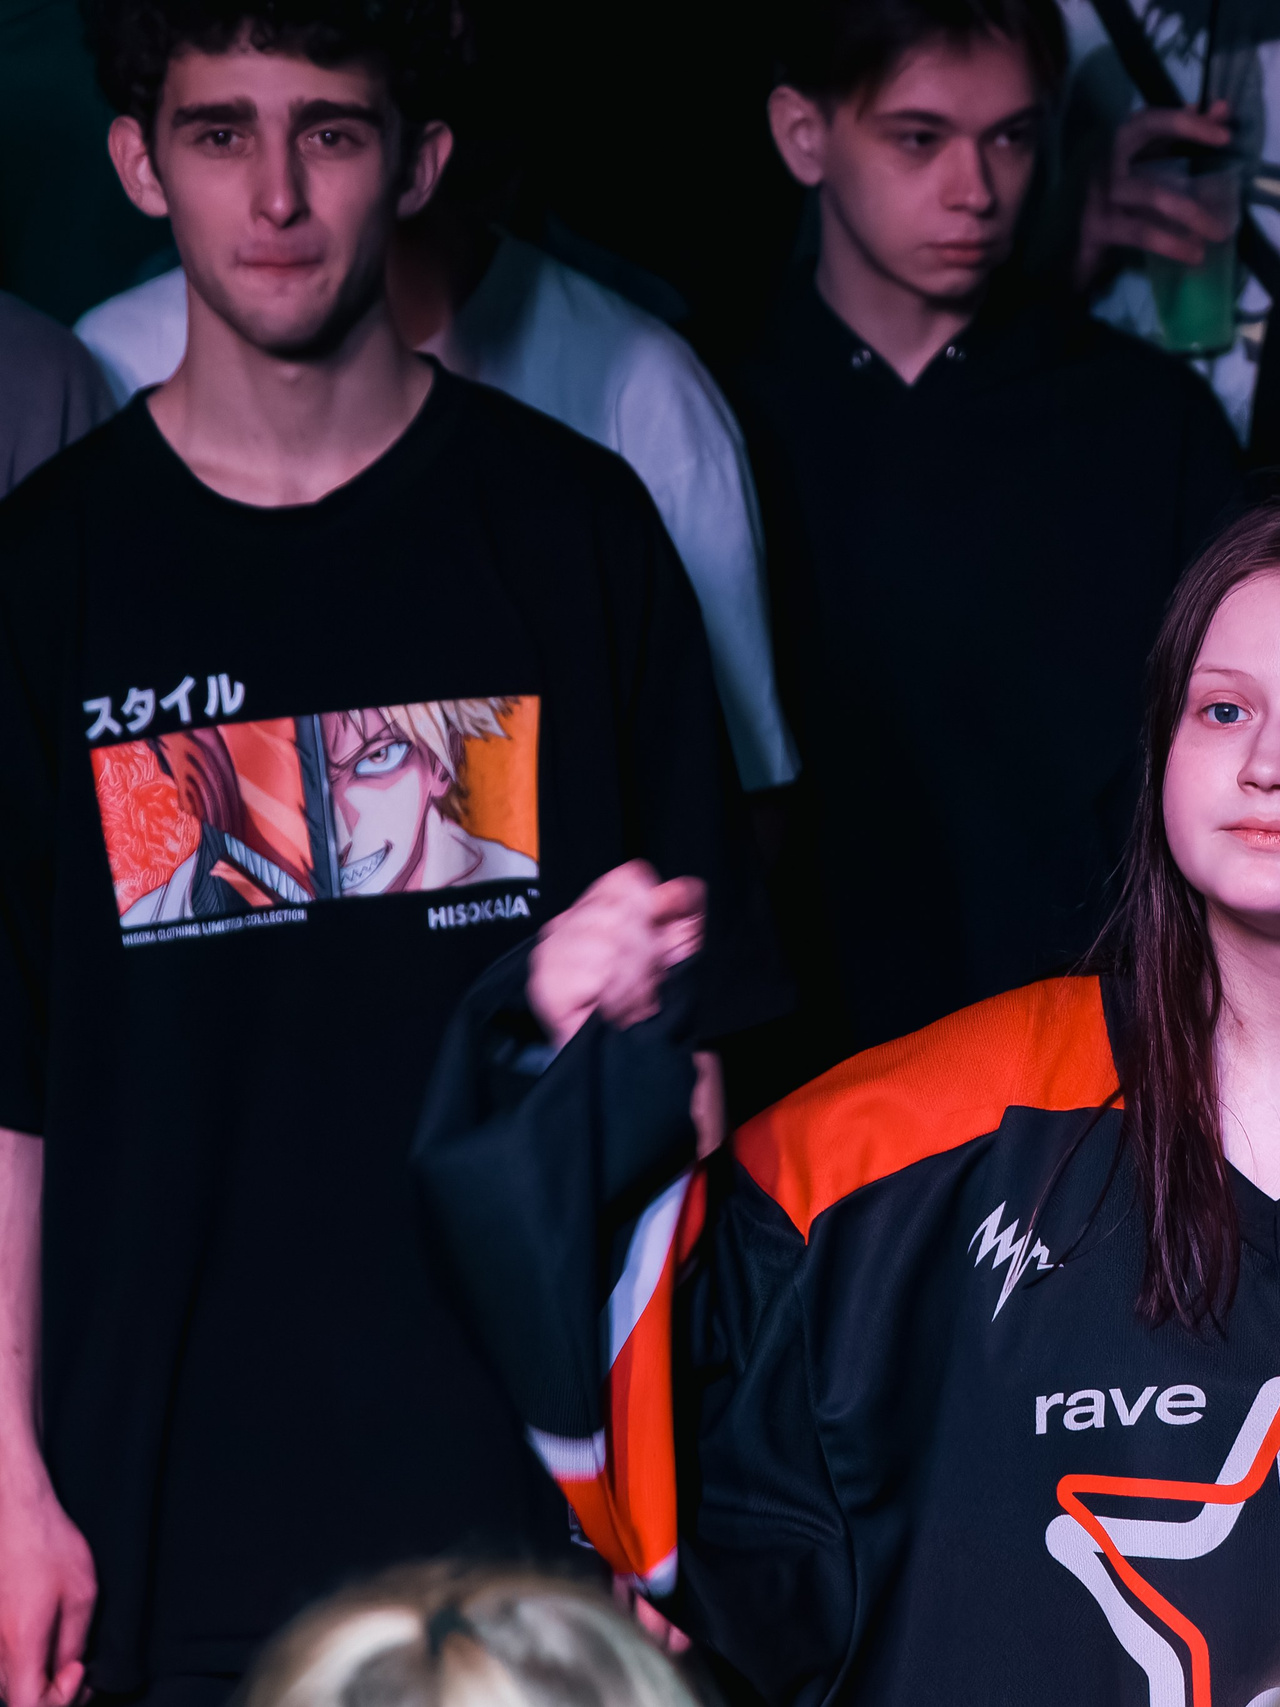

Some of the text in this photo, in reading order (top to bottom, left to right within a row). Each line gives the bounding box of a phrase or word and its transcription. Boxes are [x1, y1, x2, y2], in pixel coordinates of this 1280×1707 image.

[82, 673, 245, 741] スタイル
[243, 908, 308, 929] COLLECTION
[1035, 1384, 1207, 1435] rave
